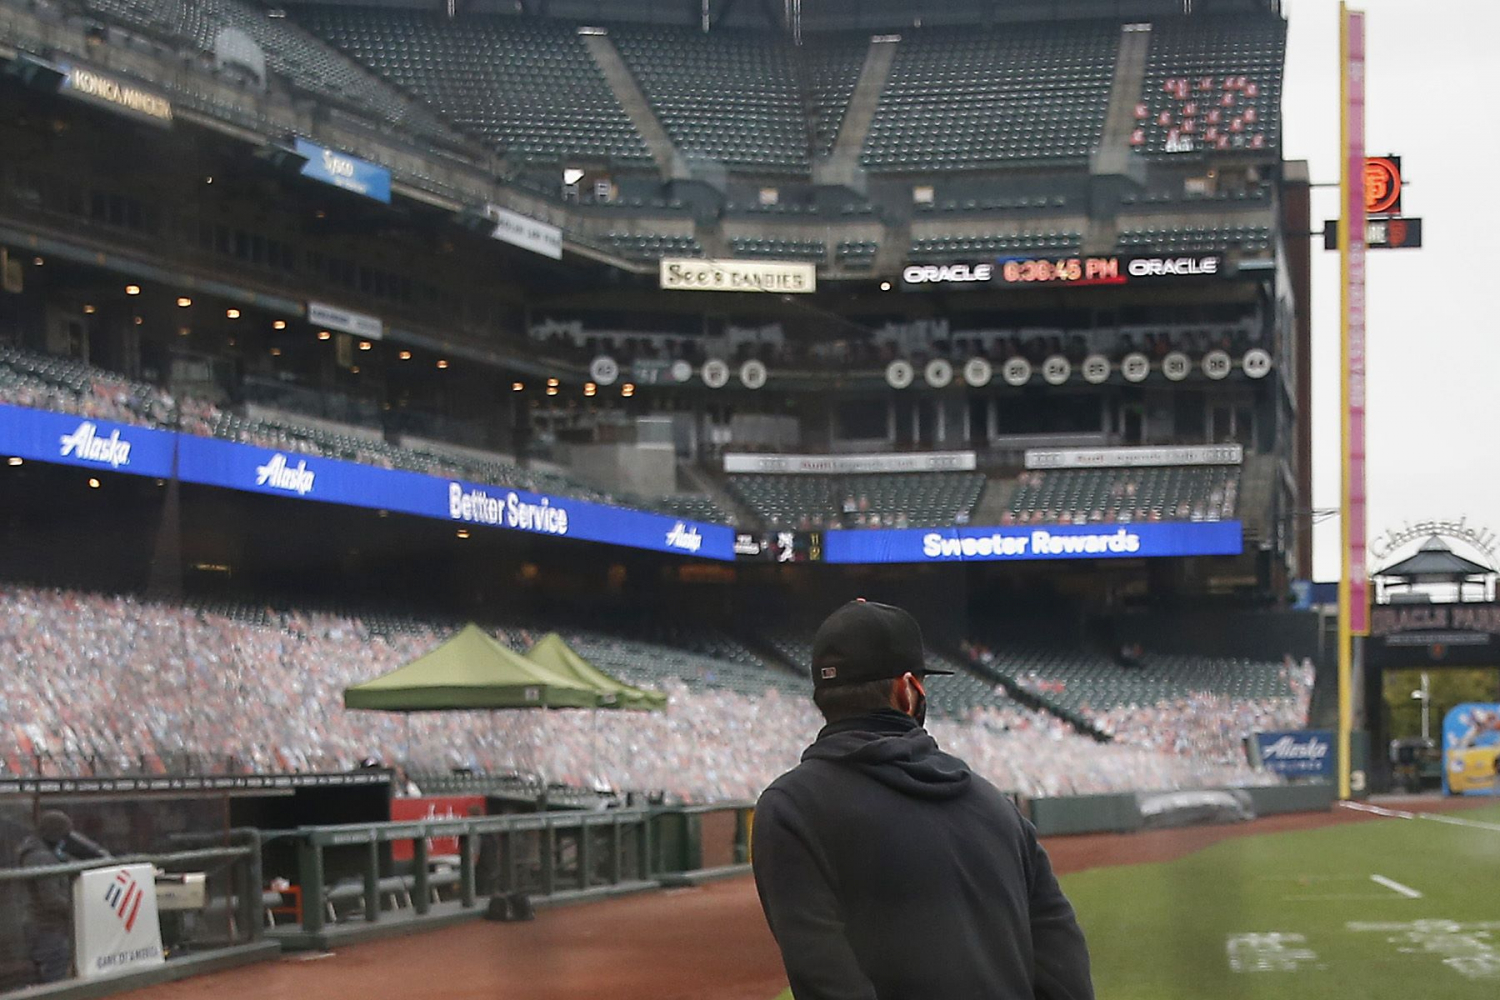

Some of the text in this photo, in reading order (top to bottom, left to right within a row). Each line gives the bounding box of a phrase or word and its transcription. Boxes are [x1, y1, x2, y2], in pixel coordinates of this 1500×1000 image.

[903, 265, 987, 283] ORACLE
[1085, 257, 1118, 279] PM
[1128, 258, 1217, 276] ORACLE
[60, 421, 131, 468] Alaska
[256, 453, 316, 494] Alaska
[449, 481, 568, 534] Better Service
[923, 529, 1140, 556] Sweeter Rewards
[1261, 735, 1329, 760] Alaska
